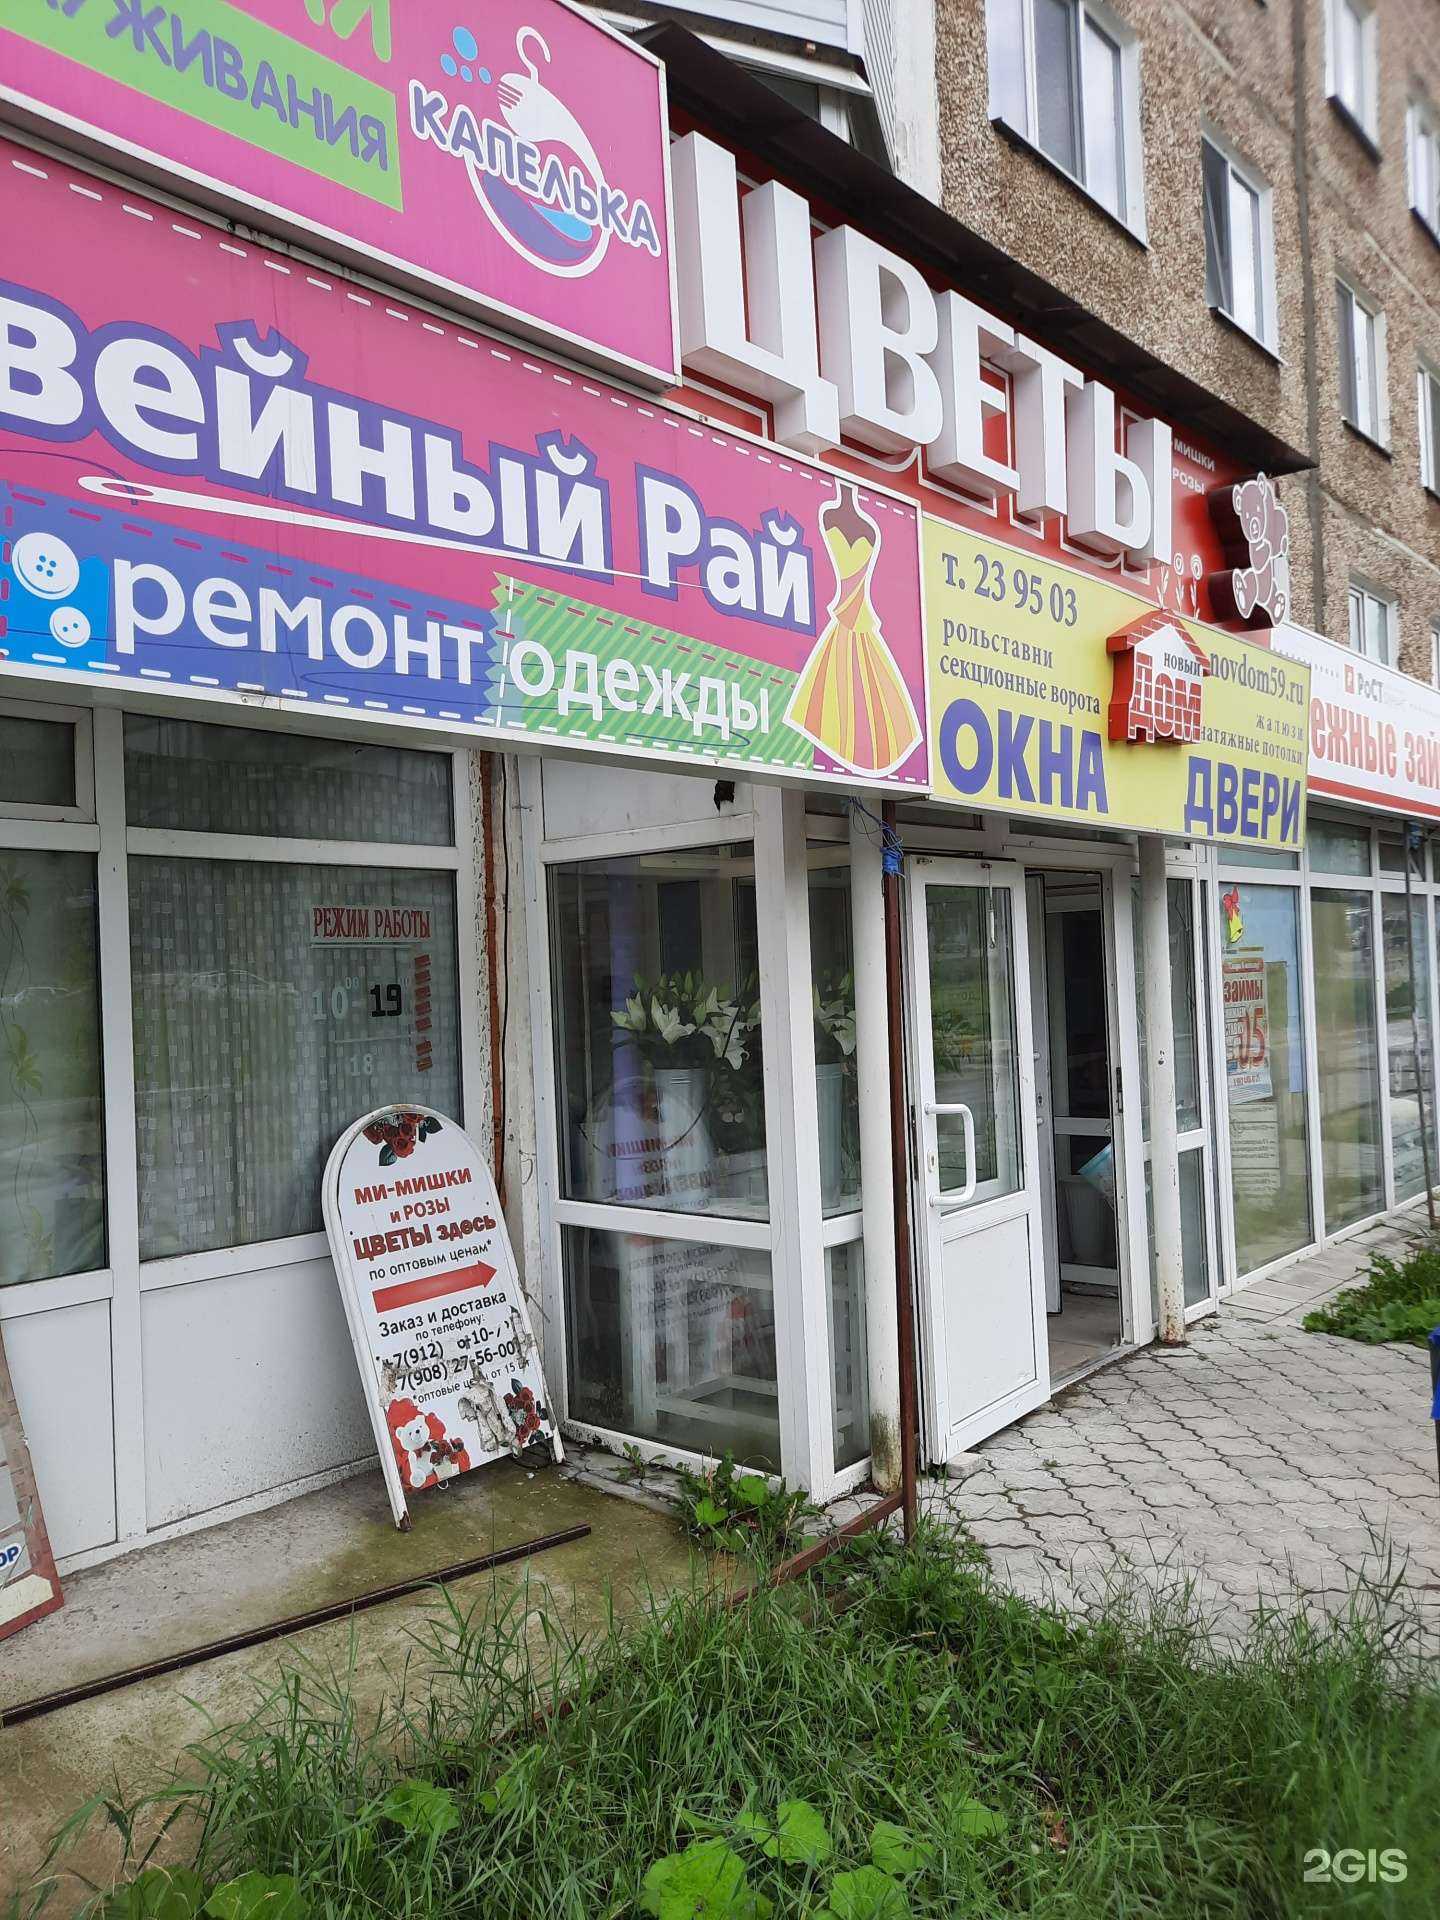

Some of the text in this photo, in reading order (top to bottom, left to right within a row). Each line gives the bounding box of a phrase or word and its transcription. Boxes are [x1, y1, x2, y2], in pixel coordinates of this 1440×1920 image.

[62, 0, 389, 171] ЖИВАНИЯ
[410, 79, 660, 256] КАПЕЛЬКА
[672, 131, 1172, 567] ЦВЕТЫ
[1172, 467, 1205, 495] РОЗЫ
[643, 476, 811, 625] Рай
[942, 553, 1078, 627] т. 23 95 03
[113, 558, 770, 741] ремонт одежды
[943, 618, 1053, 669] рольставни
[940, 655, 1101, 714] секционные ворота
[1129, 651, 1202, 744] ДОМ
[1210, 652, 1304, 706] novdom59.ru
[939, 699, 1109, 814] ОКНА
[1263, 742, 1303, 765] потолки
[1184, 755, 1301, 846] ДВЕРИ
[313, 907, 431, 939] РЕЖИМ РАБОТЫ
[370, 983, 403, 1018] 19
[403, 1197, 450, 1221] РОЗЫ
[353, 1223, 433, 1262] ЦВЕТЫ
[369, 1268, 386, 1281] по
[389, 1253, 447, 1276] оптовым
[379, 1292, 507, 1338] Заказ и доставка
[416, 1313, 486, 1342] по телефону:
[491, 1369, 502, 1379] от
[505, 1361, 516, 1374] 15
